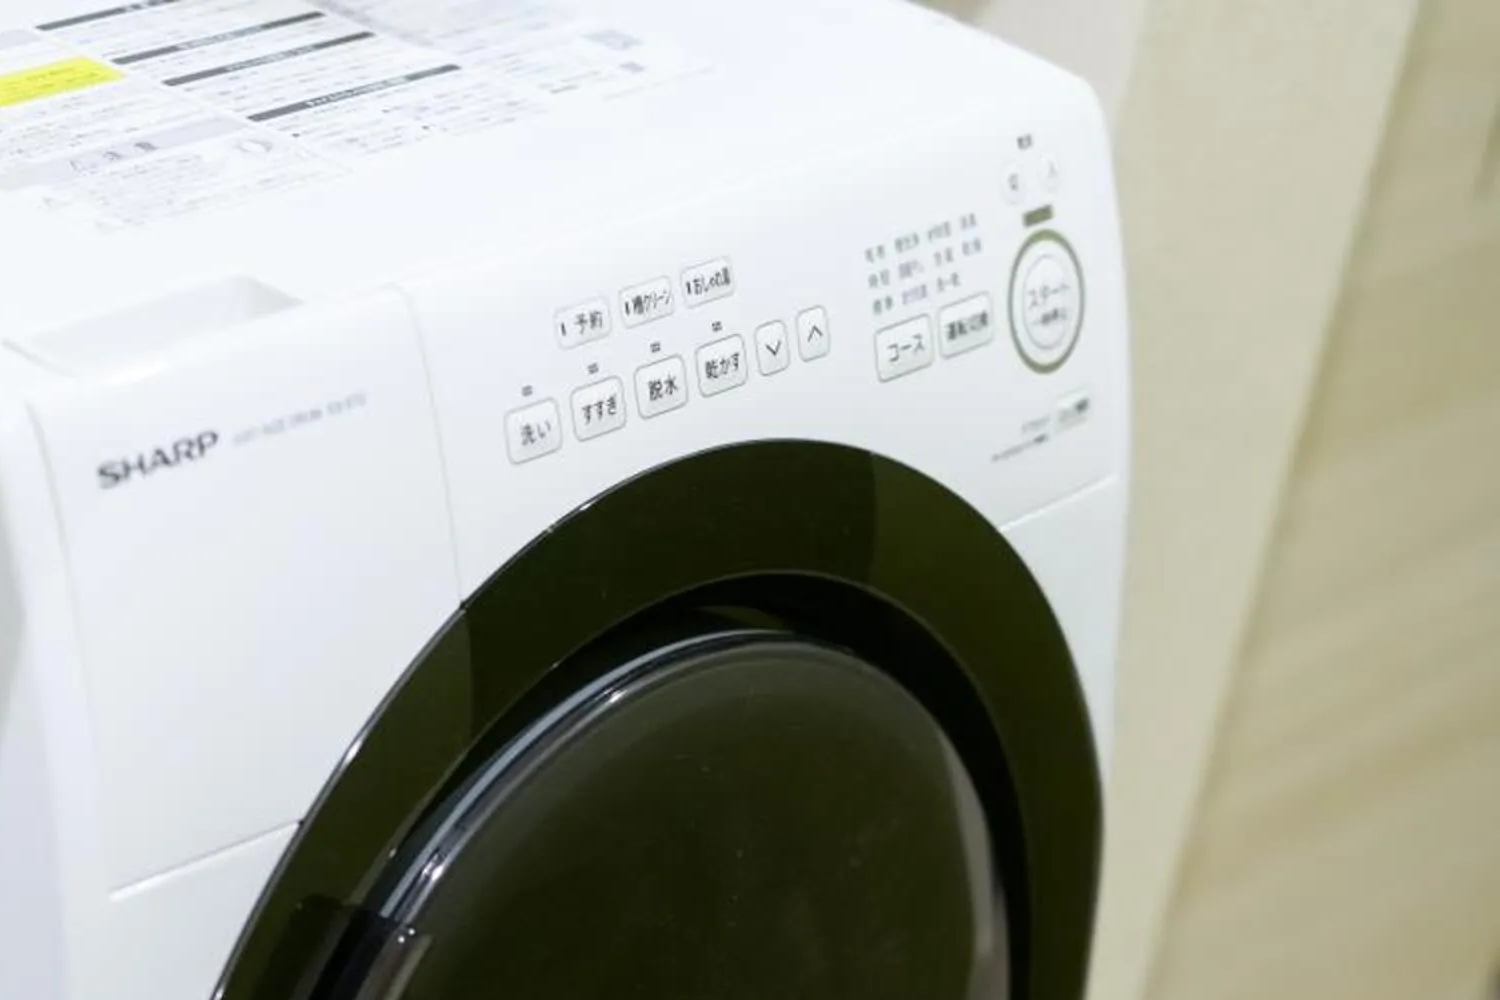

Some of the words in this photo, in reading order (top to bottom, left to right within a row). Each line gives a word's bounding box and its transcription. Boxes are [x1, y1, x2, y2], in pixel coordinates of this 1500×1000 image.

[574, 310, 603, 335] 予約
[887, 334, 926, 363] コース
[704, 353, 741, 380] 乾かす
[648, 375, 678, 401] 脱水
[581, 394, 618, 425] すすぎ
[520, 420, 551, 446] 洗い
[97, 429, 219, 490] SHARP
